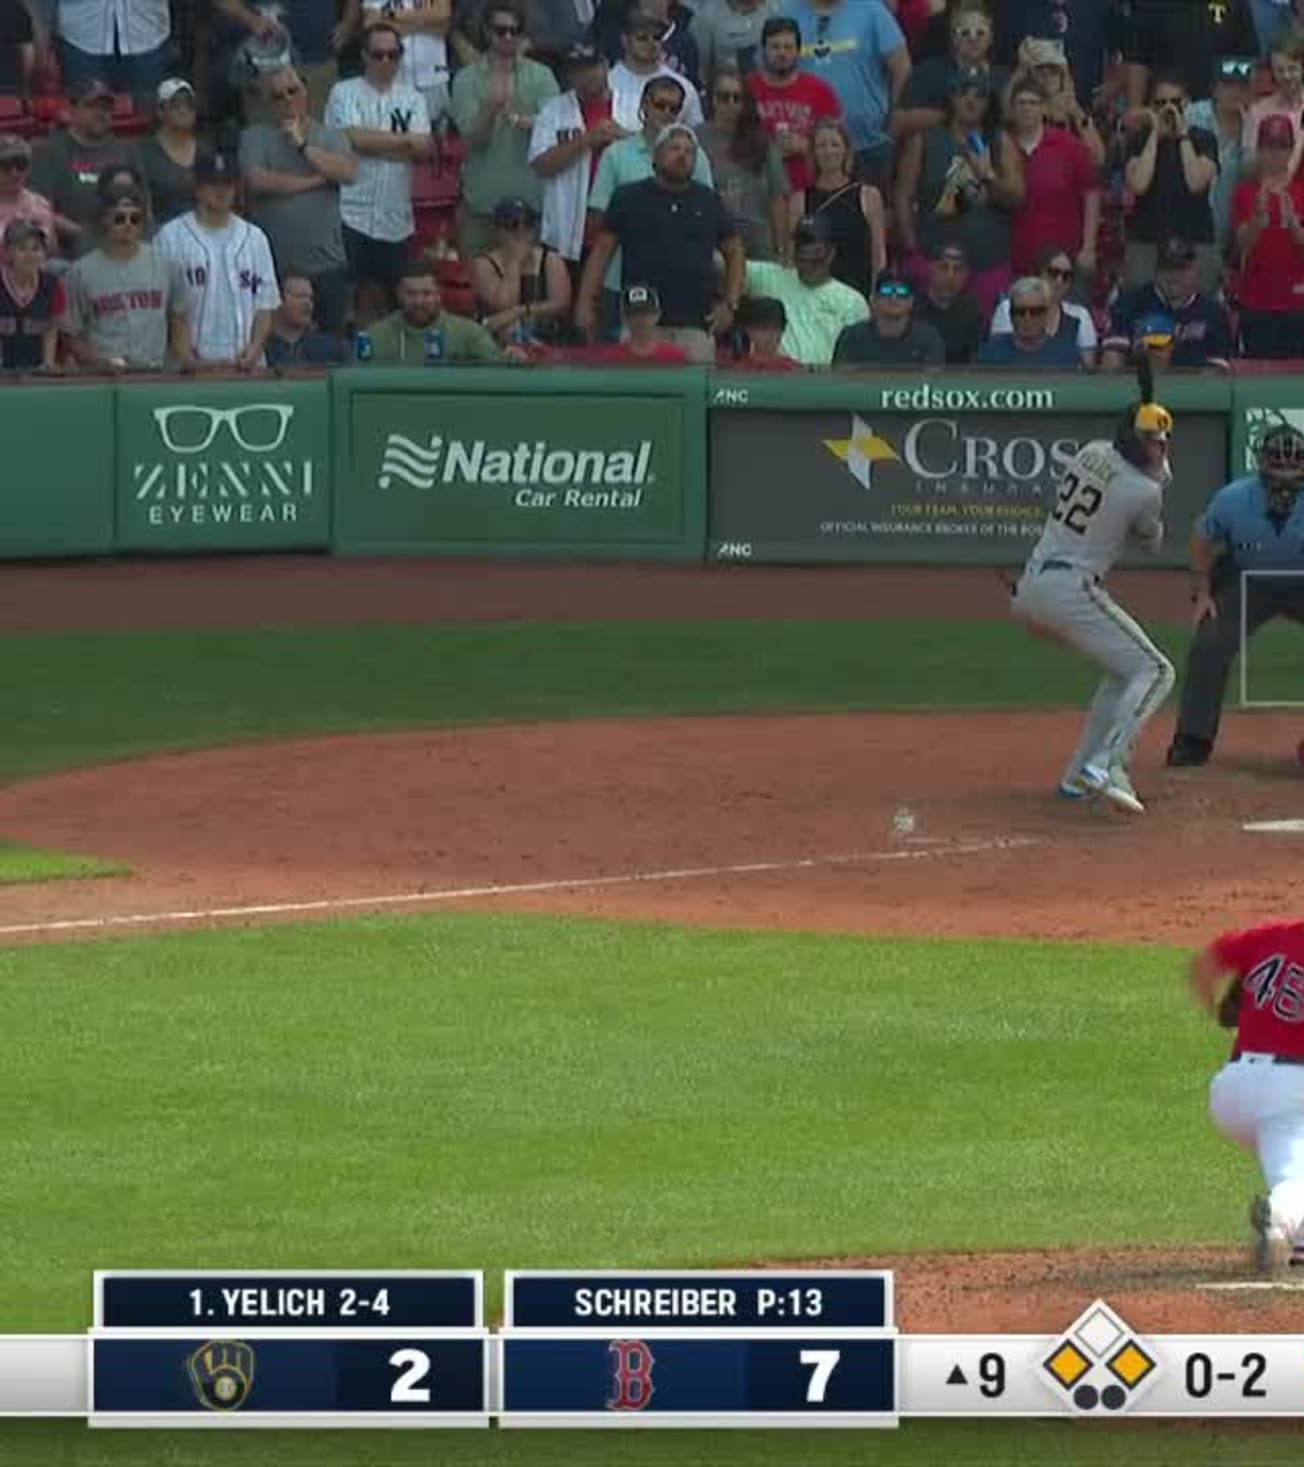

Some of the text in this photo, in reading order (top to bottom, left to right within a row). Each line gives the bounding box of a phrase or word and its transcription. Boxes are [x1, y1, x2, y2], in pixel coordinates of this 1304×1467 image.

[714, 389, 749, 404] ANC
[881, 383, 1054, 409] redsox.com
[442, 440, 651, 484] National
[134, 459, 313, 499] ZENNI
[515, 488, 642, 507] Car Rental
[1053, 471, 1103, 535] 22
[149, 503, 297, 524] EYEWEAR
[718, 543, 751, 558] ANC
